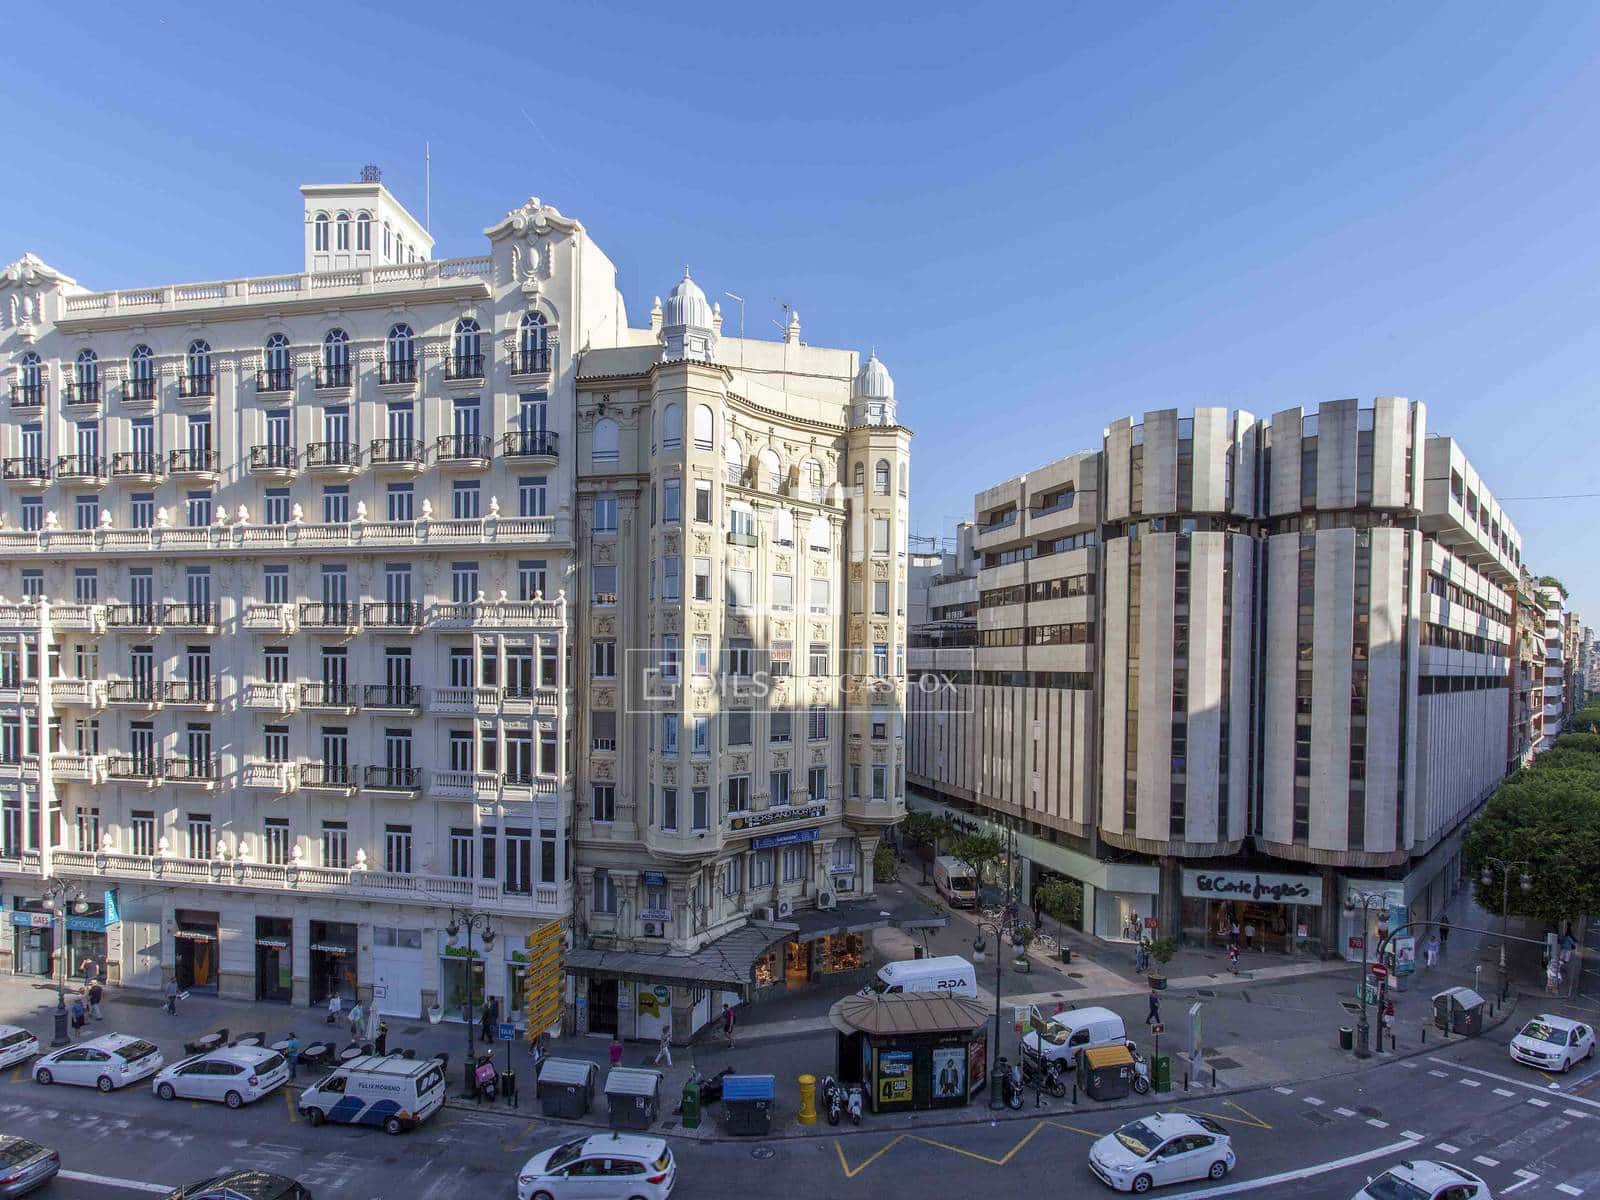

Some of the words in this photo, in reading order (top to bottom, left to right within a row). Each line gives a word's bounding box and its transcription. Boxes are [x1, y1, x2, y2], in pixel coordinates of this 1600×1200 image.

[1214, 876, 1252, 894] Corte
[1252, 874, 1310, 901] Inglés
[33, 915, 49, 925] GAES
[937, 979, 967, 989] RDA
[501, 1028, 515, 1036] TAXI
